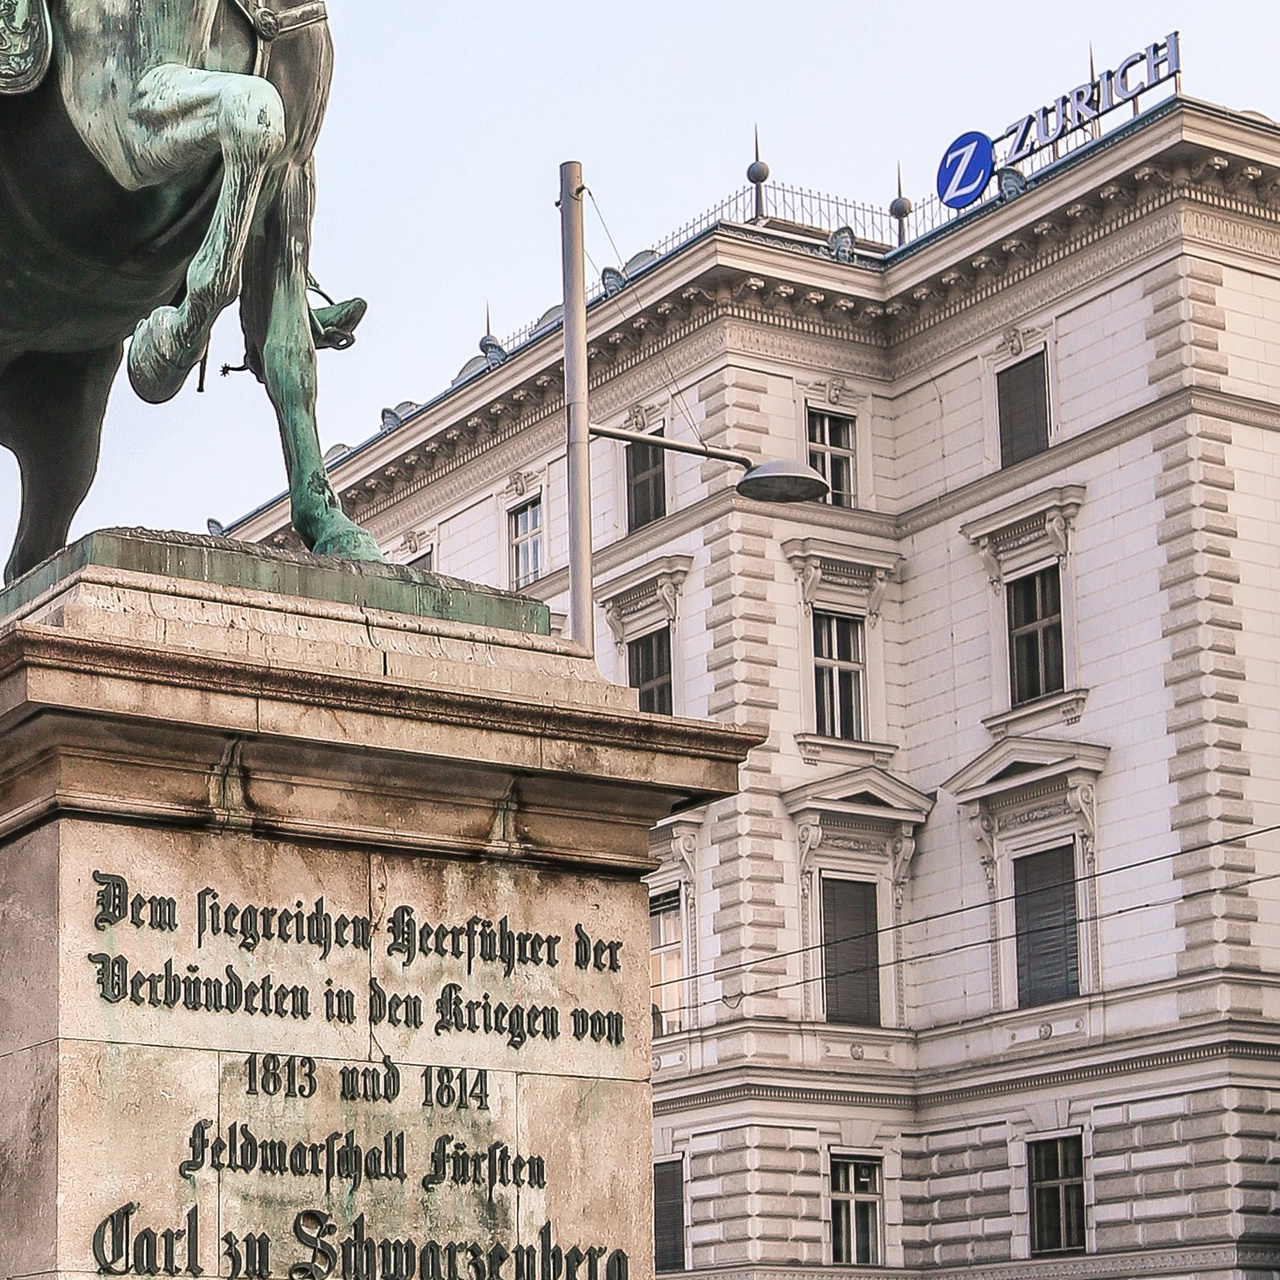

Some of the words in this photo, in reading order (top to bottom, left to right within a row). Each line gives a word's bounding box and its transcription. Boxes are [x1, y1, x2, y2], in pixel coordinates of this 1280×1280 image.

[1004, 30, 1181, 165] ZURICH
[93, 870, 178, 931] Dem
[387, 906, 561, 977] Heerführer
[575, 924, 625, 972] der
[88, 953, 311, 1020] Verbündeten
[323, 979, 355, 1024] in
[370, 977, 424, 1028] den
[436, 983, 560, 1048] Kriegen
[571, 1008, 625, 1045] von
[244, 1053, 317, 1099] 1813
[340, 1056, 401, 1103] und
[422, 1065, 490, 1110] 1814
[179, 1120, 408, 1197] Feldmarschall
[422, 1134, 547, 1201] Fürsten
[92, 1201, 204, 1276] Carl
